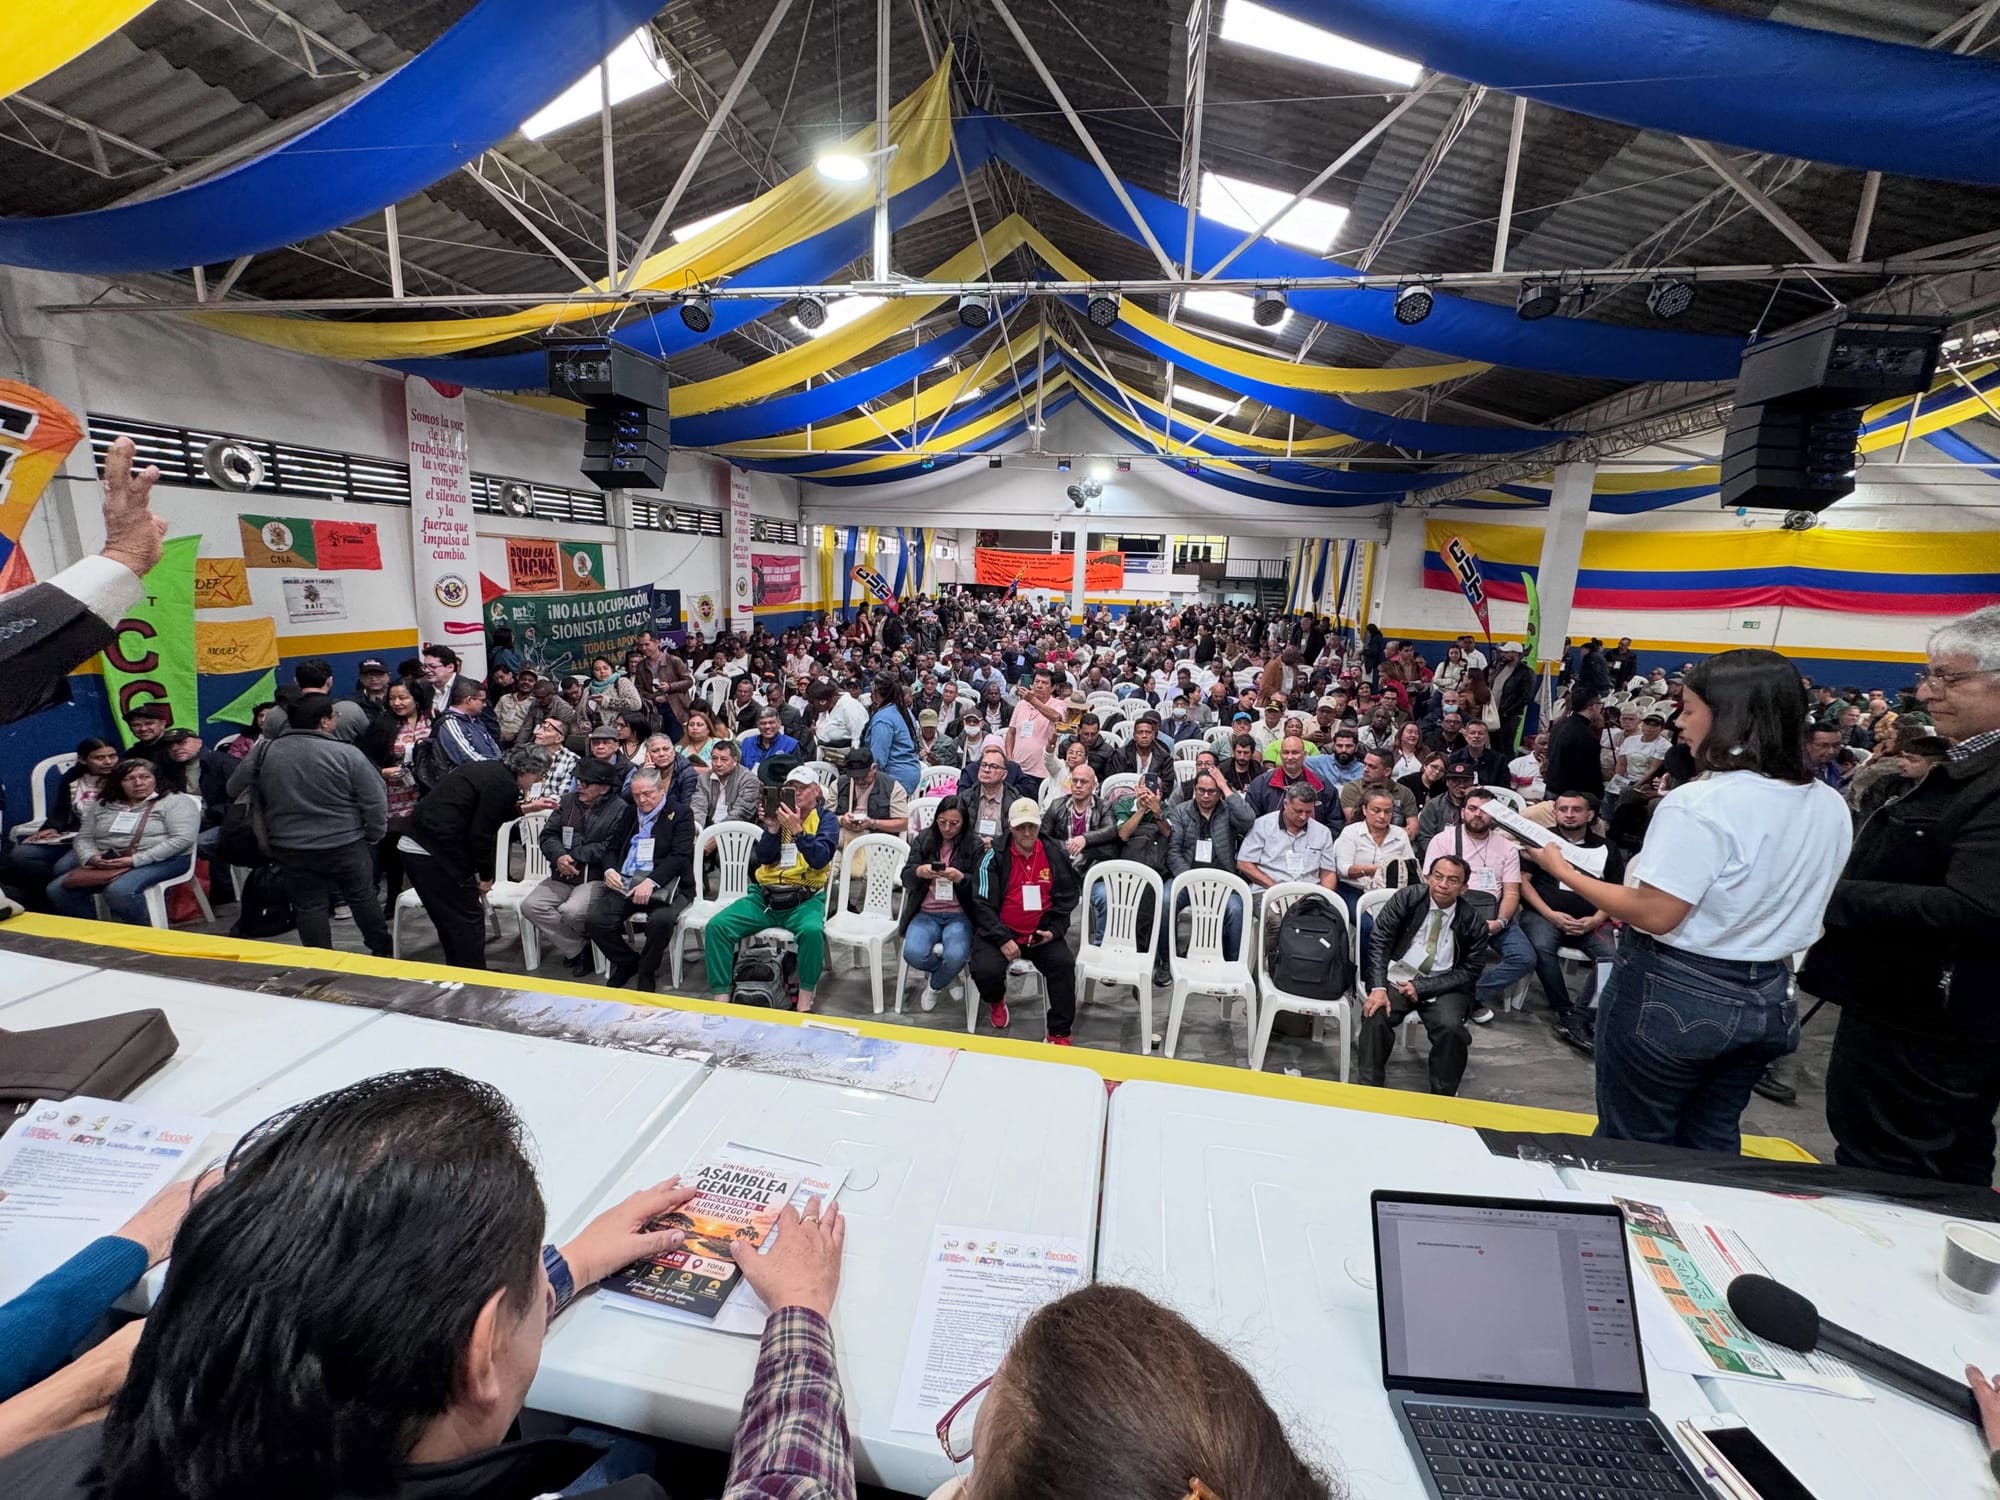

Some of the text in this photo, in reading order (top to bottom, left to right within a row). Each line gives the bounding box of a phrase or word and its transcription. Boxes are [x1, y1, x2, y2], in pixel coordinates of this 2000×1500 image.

[411, 408, 464, 432] Somos la voz
[429, 427, 438, 440] de
[422, 456, 431, 469] la
[432, 476, 458, 490] rompe
[426, 488, 466, 503] el silencio
[438, 504, 454, 518] y la
[421, 516, 468, 534] fuerza que
[423, 532, 470, 547] impulsa al
[271, 555, 292, 563] CNA
[432, 548, 466, 560] cambio.
[1448, 538, 1483, 602] CUT
[856, 567, 890, 599] CUT
[548, 590, 649, 620] ¡NO A LA OCUPACIÓN
[552, 619, 605, 640] SIONISTA
[608, 616, 622, 632] DE
[584, 641, 606, 655] TODO
[607, 639, 616, 650] EL
[697, 1166, 788, 1194] ASAMBLEA
[696, 1179, 771, 1204] GENERAL
[684, 1205, 753, 1225] BIENESTAR SOCIAL
[696, 1200, 743, 1215] LIDERAZGO
[706, 1262, 726, 1272] YOPAL
